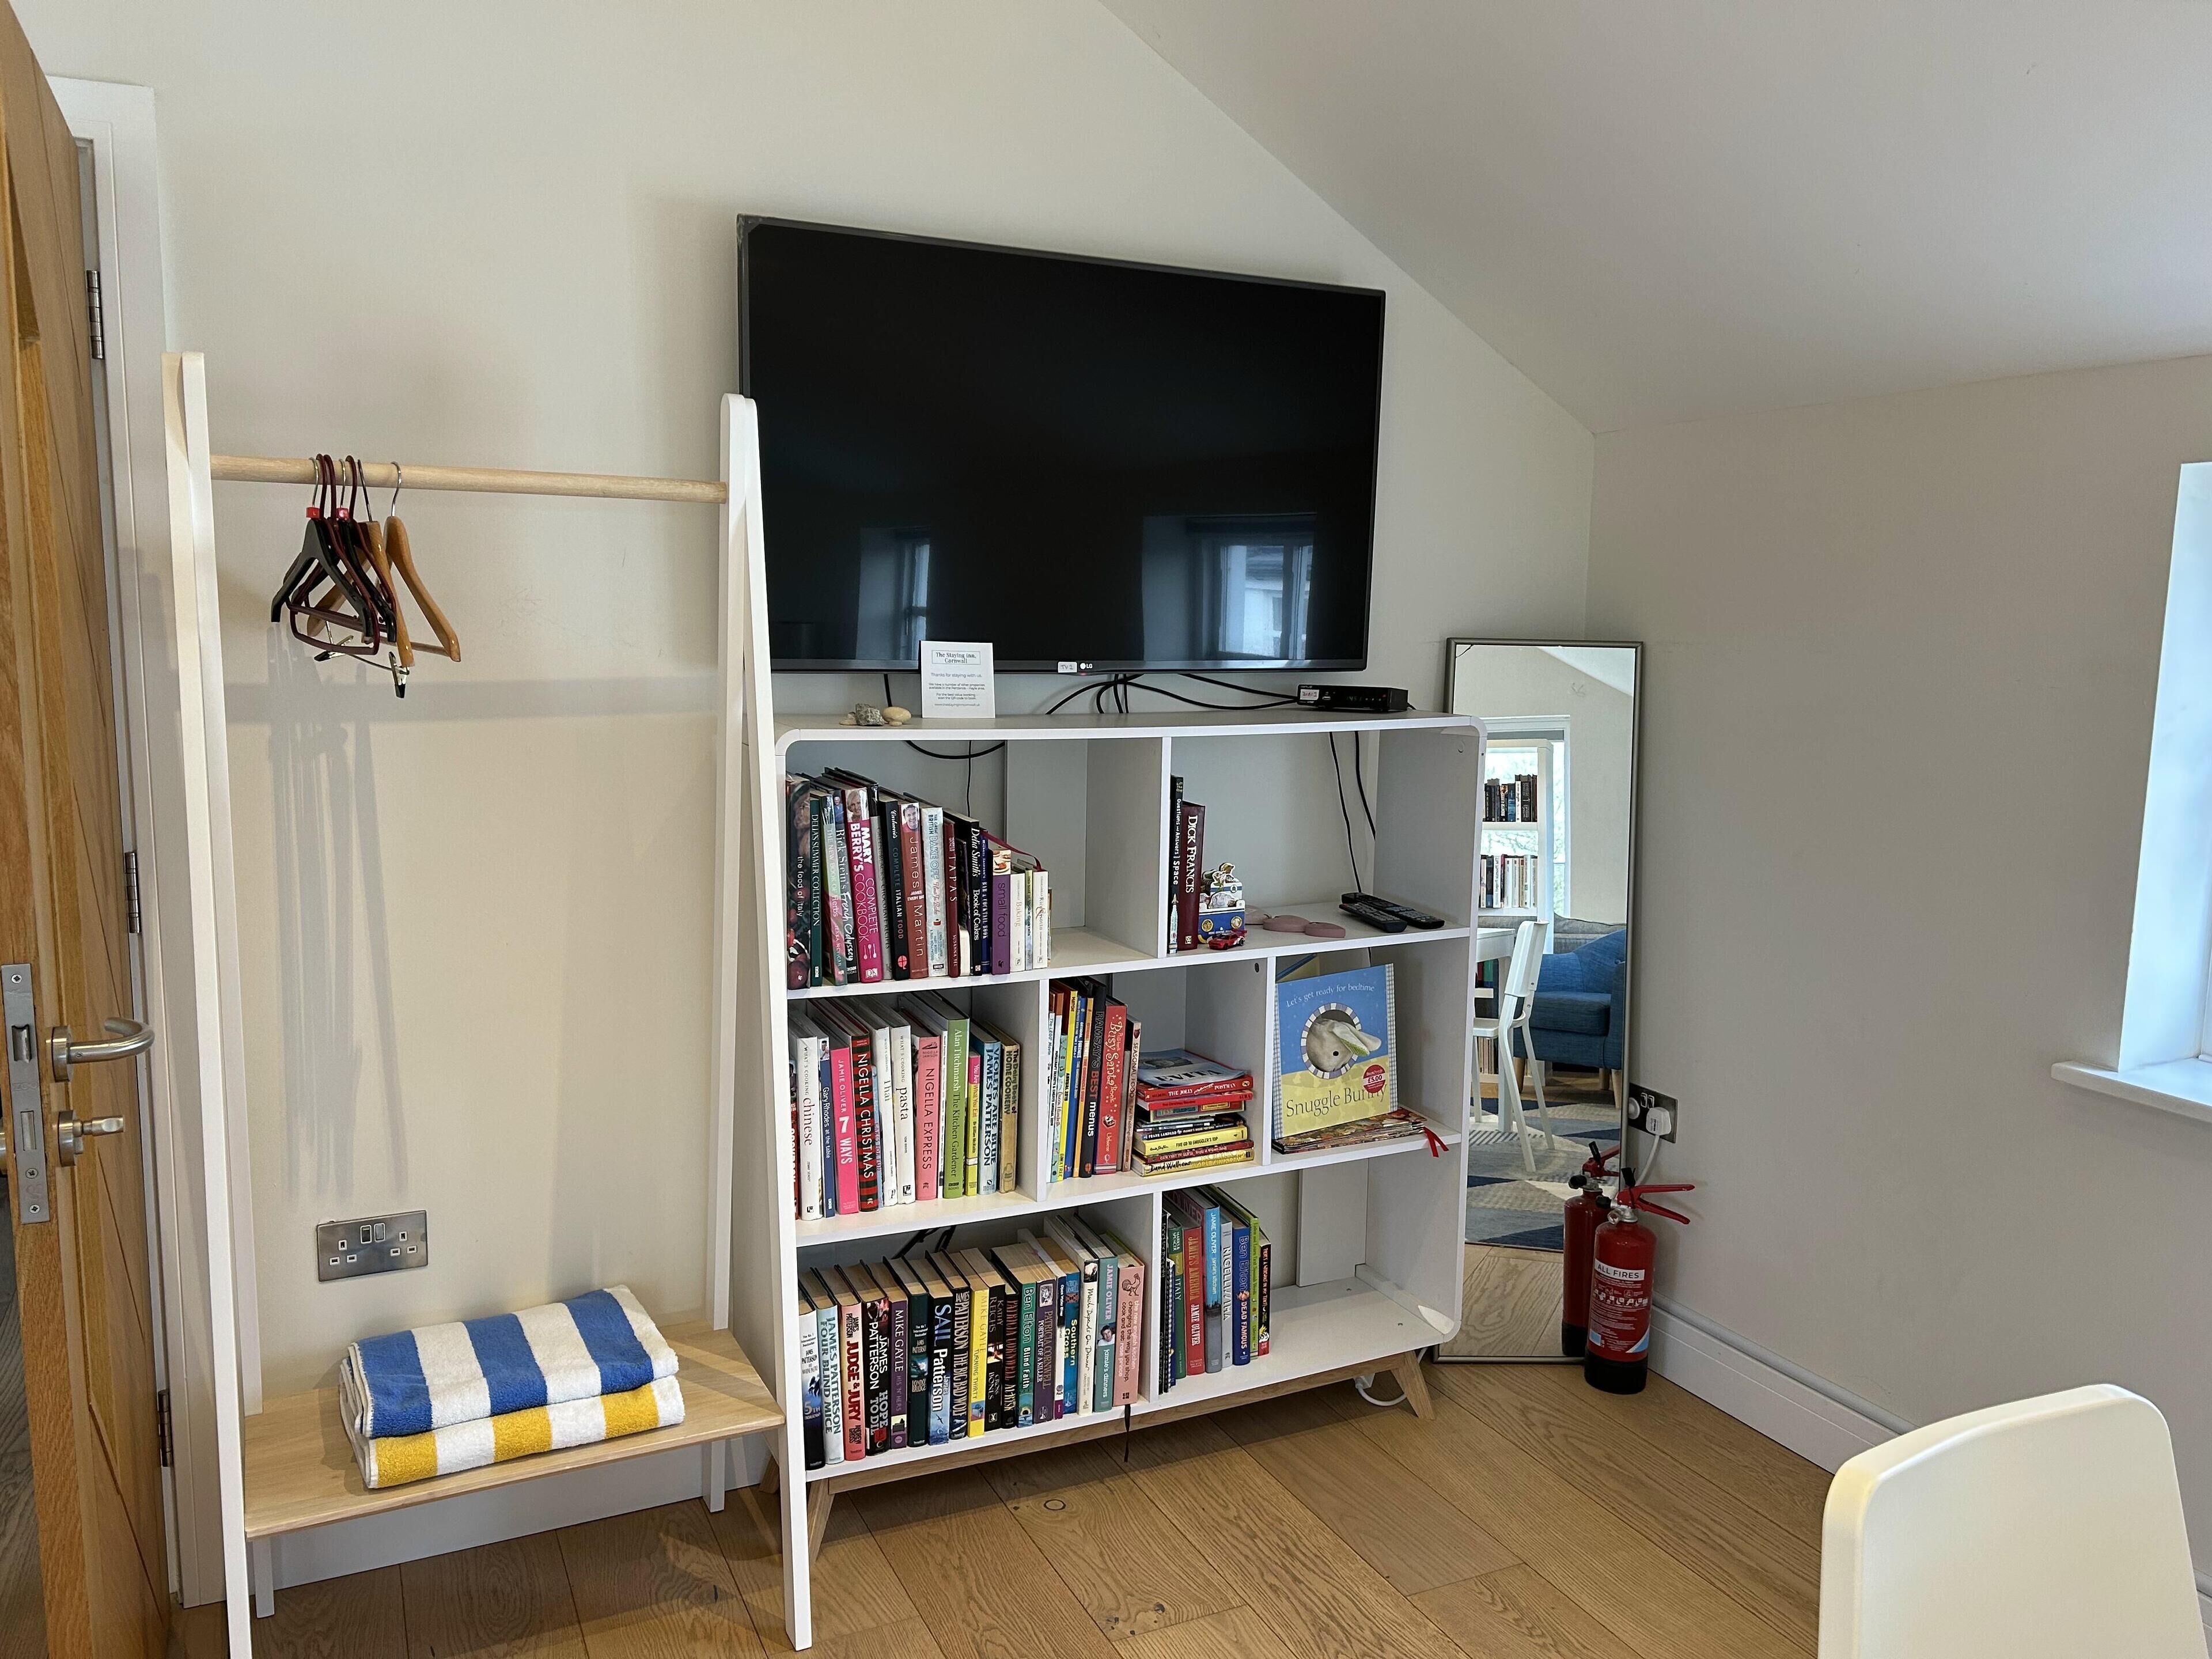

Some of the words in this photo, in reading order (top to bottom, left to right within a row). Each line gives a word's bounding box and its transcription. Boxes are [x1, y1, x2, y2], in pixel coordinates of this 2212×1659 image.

[861, 827, 873, 864] MARY
[971, 828, 980, 849] Delia
[1188, 815, 1198, 844] DICK
[850, 823, 864, 872] BERRY'S
[910, 837, 919, 888] James
[892, 848, 900, 887] COMPLETE
[1185, 846, 1196, 893] FRANCIS
[836, 830, 846, 851] Rick
[844, 923, 855, 961] Odyssey
[854, 873, 869, 943] COOKBOOK
[865, 878, 878, 934] COMPLETE
[998, 883, 1007, 910] small
[914, 904, 923, 956] Martin
[997, 914, 1007, 937] food
[1286, 995, 1302, 1007] Let's
[1304, 991, 1315, 1002] get
[1316, 986, 1335, 997] ready
[1336, 984, 1346, 992] for
[1349, 983, 1375, 992] bedtime
[954, 1029, 962, 1048] Alan
[1092, 1011, 1104, 1068] RAMSAY'S
[1105, 1021, 1123, 1051] Busy
[953, 1048, 962, 1091] Titchmarsh
[986, 1048, 994, 1090] JAMES
[993, 1047, 1001, 1100] VIOLETS
[1131, 1043, 1139, 1076] SEASONAL
[1154, 1069, 1222, 1082] EVITA
[858, 1053, 870, 1105] NIGELLA
[924, 1069, 935, 1117] NIGELLA
[1089, 1071, 1099, 1098] BEST
[1368, 1075, 1382, 1084] £5.00
[822, 1103, 830, 1127] Rhodes
[839, 1085, 847, 1113] OLIVER
[896, 1087, 909, 1120] pasta
[1286, 1090, 1340, 1117] Snuggle
[803, 1097, 815, 1146] chinese
[839, 1116, 850, 1134] 7
[952, 1109, 960, 1140] Kitchen
[984, 1093, 993, 1166] PATTERSON
[1088, 1101, 1096, 1137] menus
[839, 1138, 853, 1164] WAYS
[861, 1109, 874, 1179] CHRISTMAS
[922, 1123, 933, 1169] EXPRESS
[951, 1141, 959, 1177] Gardener
[1148, 1164, 1165, 1173] David
[1239, 1235, 1249, 1259] Ben
[1189, 1267, 1200, 1300] AMERICA
[1239, 1259, 1249, 1292] Elton
[1597, 1263, 1611, 1275] ALL
[1613, 1270, 1639, 1279] FIRES
[956, 1291, 969, 1302] JAMES
[980, 1296, 988, 1320] MIKE
[1024, 1287, 1035, 1310] Ben
[895, 1310, 904, 1338] MIKE
[934, 1304, 952, 1347] SAIL
[954, 1301, 969, 1350] PATTERSON
[989, 1297, 997, 1332] REICHS
[1022, 1311, 1035, 1344] Elton
[1043, 1310, 1054, 1346] PATRICIA
[1084, 1309, 1093, 1333] Depends
[1191, 1304, 1200, 1323] JAMIE
[820, 1321, 828, 1356] FOUR
[826, 1316, 838, 1361] JAMES
[1070, 1319, 1078, 1366] Southern
[1191, 1324, 1200, 1346] OLIVER
[847, 1341, 859, 1382] JUDGE
[869, 1321, 879, 1390] PATTERSON
[879, 1335, 888, 1374] JAMES
[895, 1339, 904, 1372] GAYLE
[953, 1351, 968, 1368] THE
[1042, 1346, 1052, 1389] CORNWELL
[822, 1359, 831, 1397] BLIND
[932, 1348, 948, 1412] Patterson
[953, 1368, 968, 1381] BIG
[953, 1381, 968, 1397] BAD
[1022, 1369, 1031, 1389] Faith
[831, 1363, 841, 1434] PATTERSON
[848, 1389, 861, 1421] JURY
[870, 1397, 879, 1414] TO
[879, 1390, 888, 1429] HOPE
[952, 1397, 967, 1416] WOLF
[824, 1402, 832, 1434] MICE
